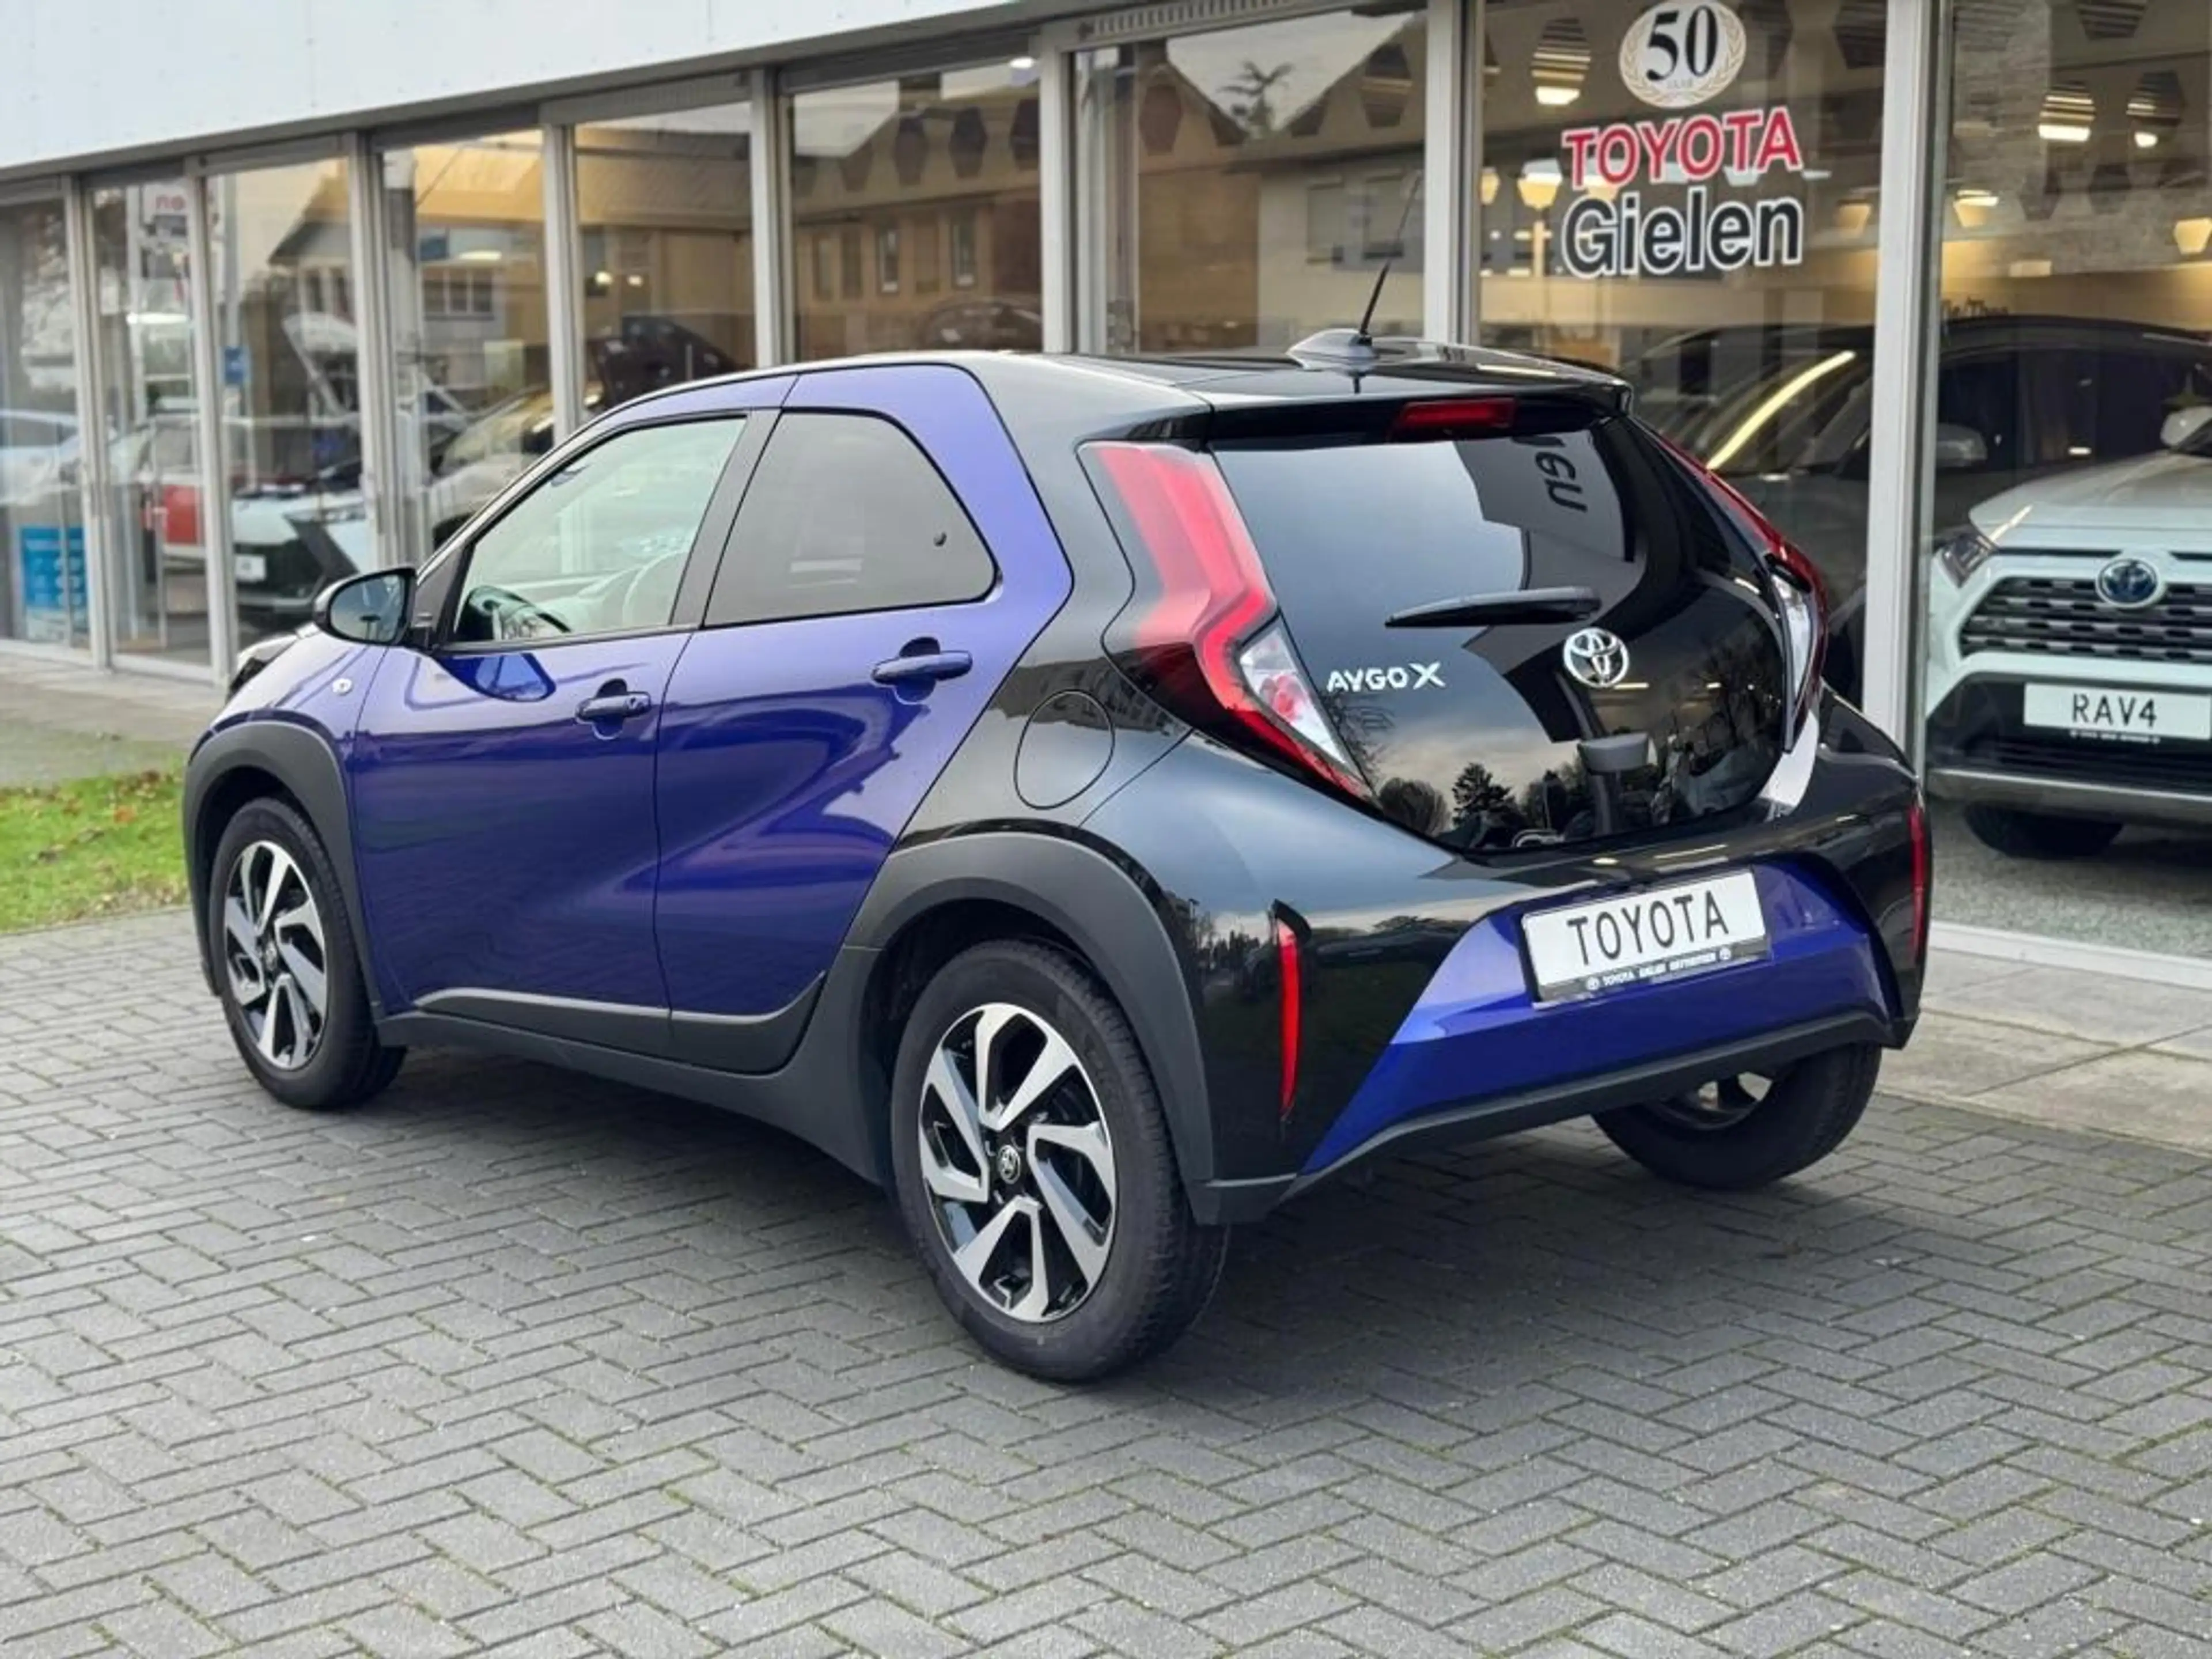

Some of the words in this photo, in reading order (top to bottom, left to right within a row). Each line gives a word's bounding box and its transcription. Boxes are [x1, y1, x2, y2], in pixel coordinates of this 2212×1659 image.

[1646, 5, 1718, 81] 50
[1562, 105, 1803, 191] TOYOTA
[1562, 185, 1804, 279] Gielen
[1326, 666, 1409, 692] AYGO
[1408, 660, 1447, 690] X
[2072, 692, 2157, 728] RAV4
[1566, 890, 1729, 965] TOYOTA
